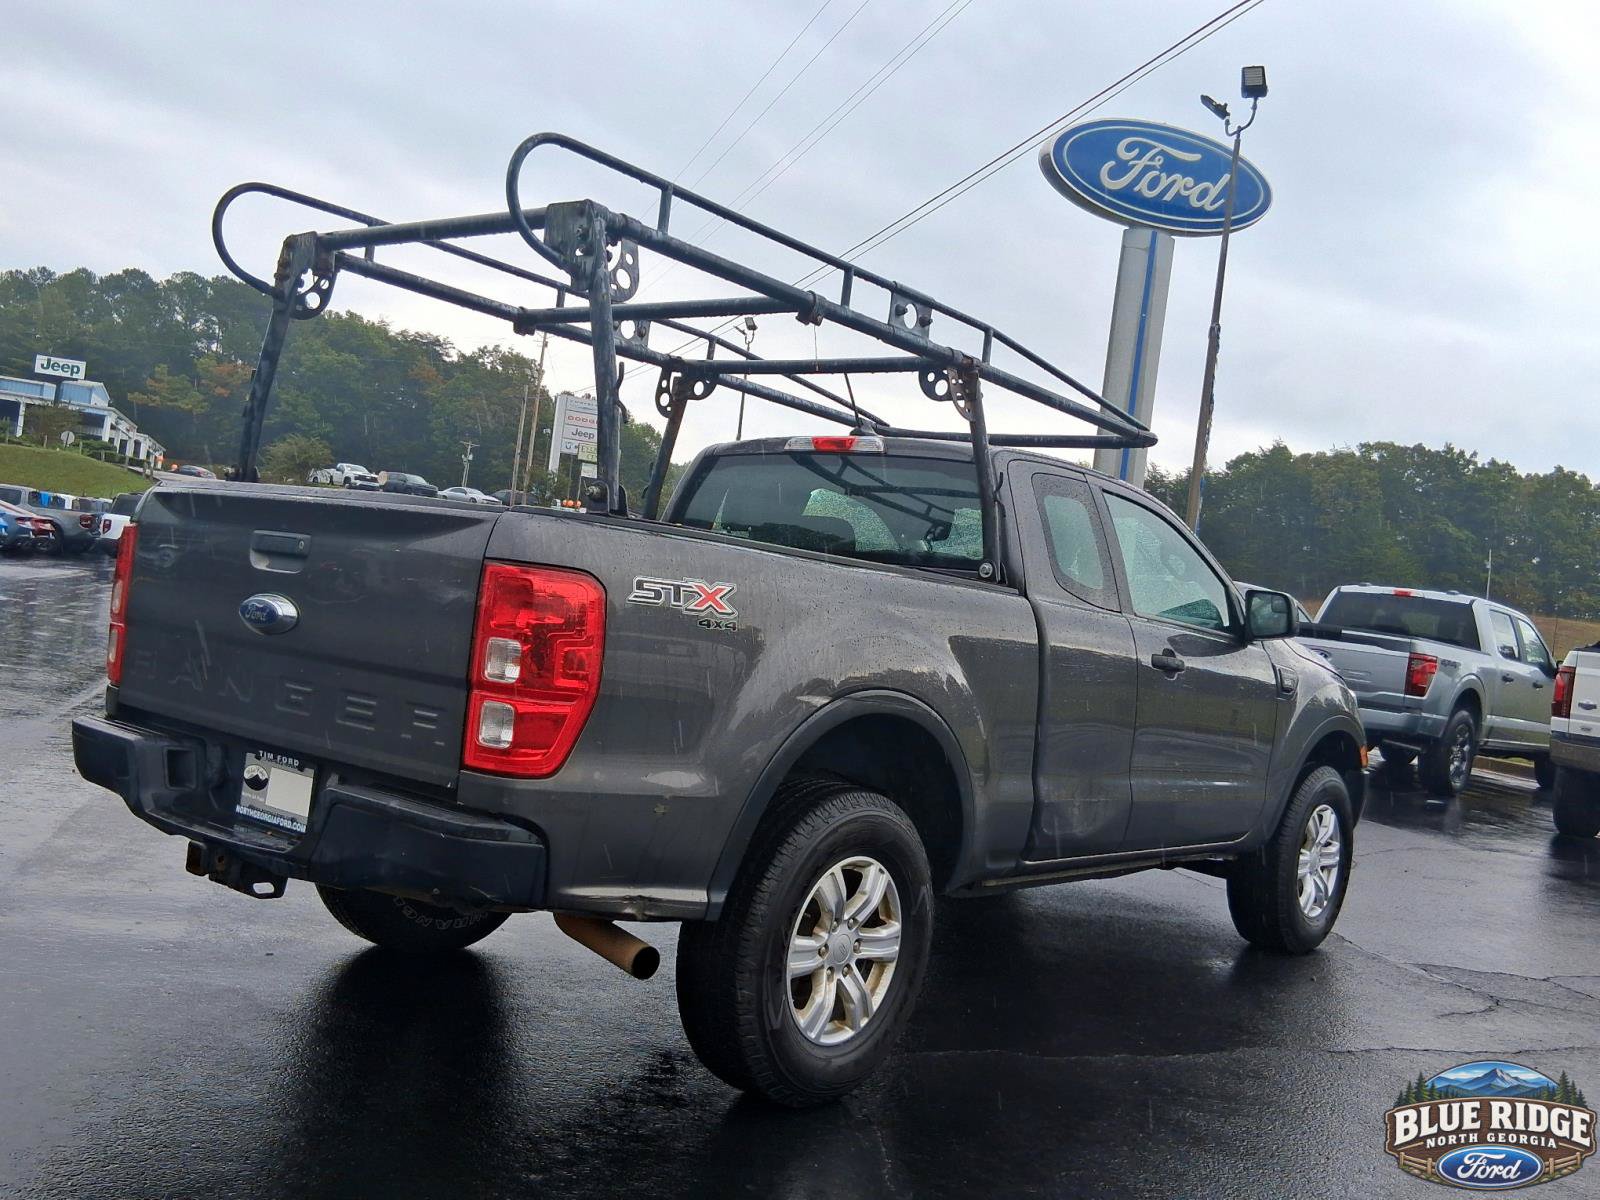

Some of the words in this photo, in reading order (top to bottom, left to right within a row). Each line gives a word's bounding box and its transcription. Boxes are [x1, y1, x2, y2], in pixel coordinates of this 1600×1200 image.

[1100, 137, 1231, 211] Ford
[41, 358, 80, 376] Jeep
[567, 415, 598, 425] DODG
[572, 428, 595, 440] Jeep
[626, 576, 738, 619] STX
[259, 750, 274, 760] TIM
[277, 755, 300, 766] FORD
[236, 804, 306, 833] NORTHGEORGIAFORD.COM
